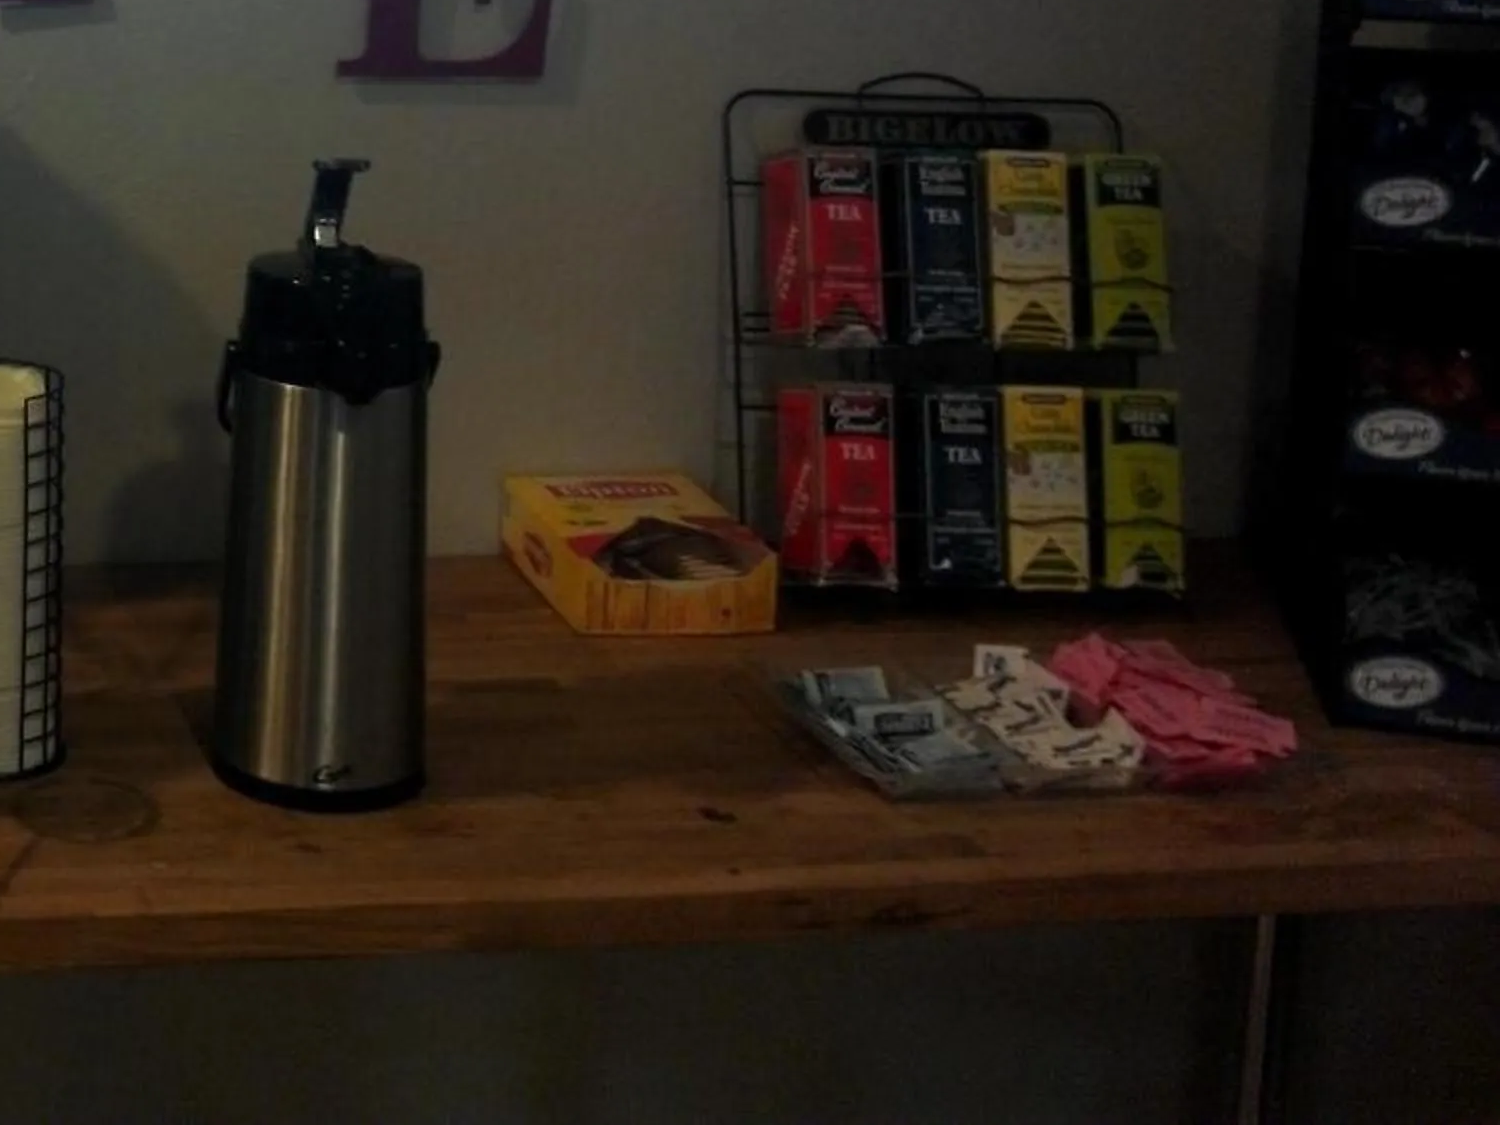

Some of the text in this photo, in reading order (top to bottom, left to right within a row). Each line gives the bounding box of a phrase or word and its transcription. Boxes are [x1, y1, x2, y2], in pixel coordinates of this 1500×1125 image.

[826, 113, 1028, 143] BIGELOW
[1114, 186, 1145, 202] TEA
[826, 203, 863, 222] TEA
[923, 207, 962, 226] TEA
[1129, 424, 1162, 439] TEA
[839, 442, 876, 461] TEA
[942, 446, 984, 466] TEA
